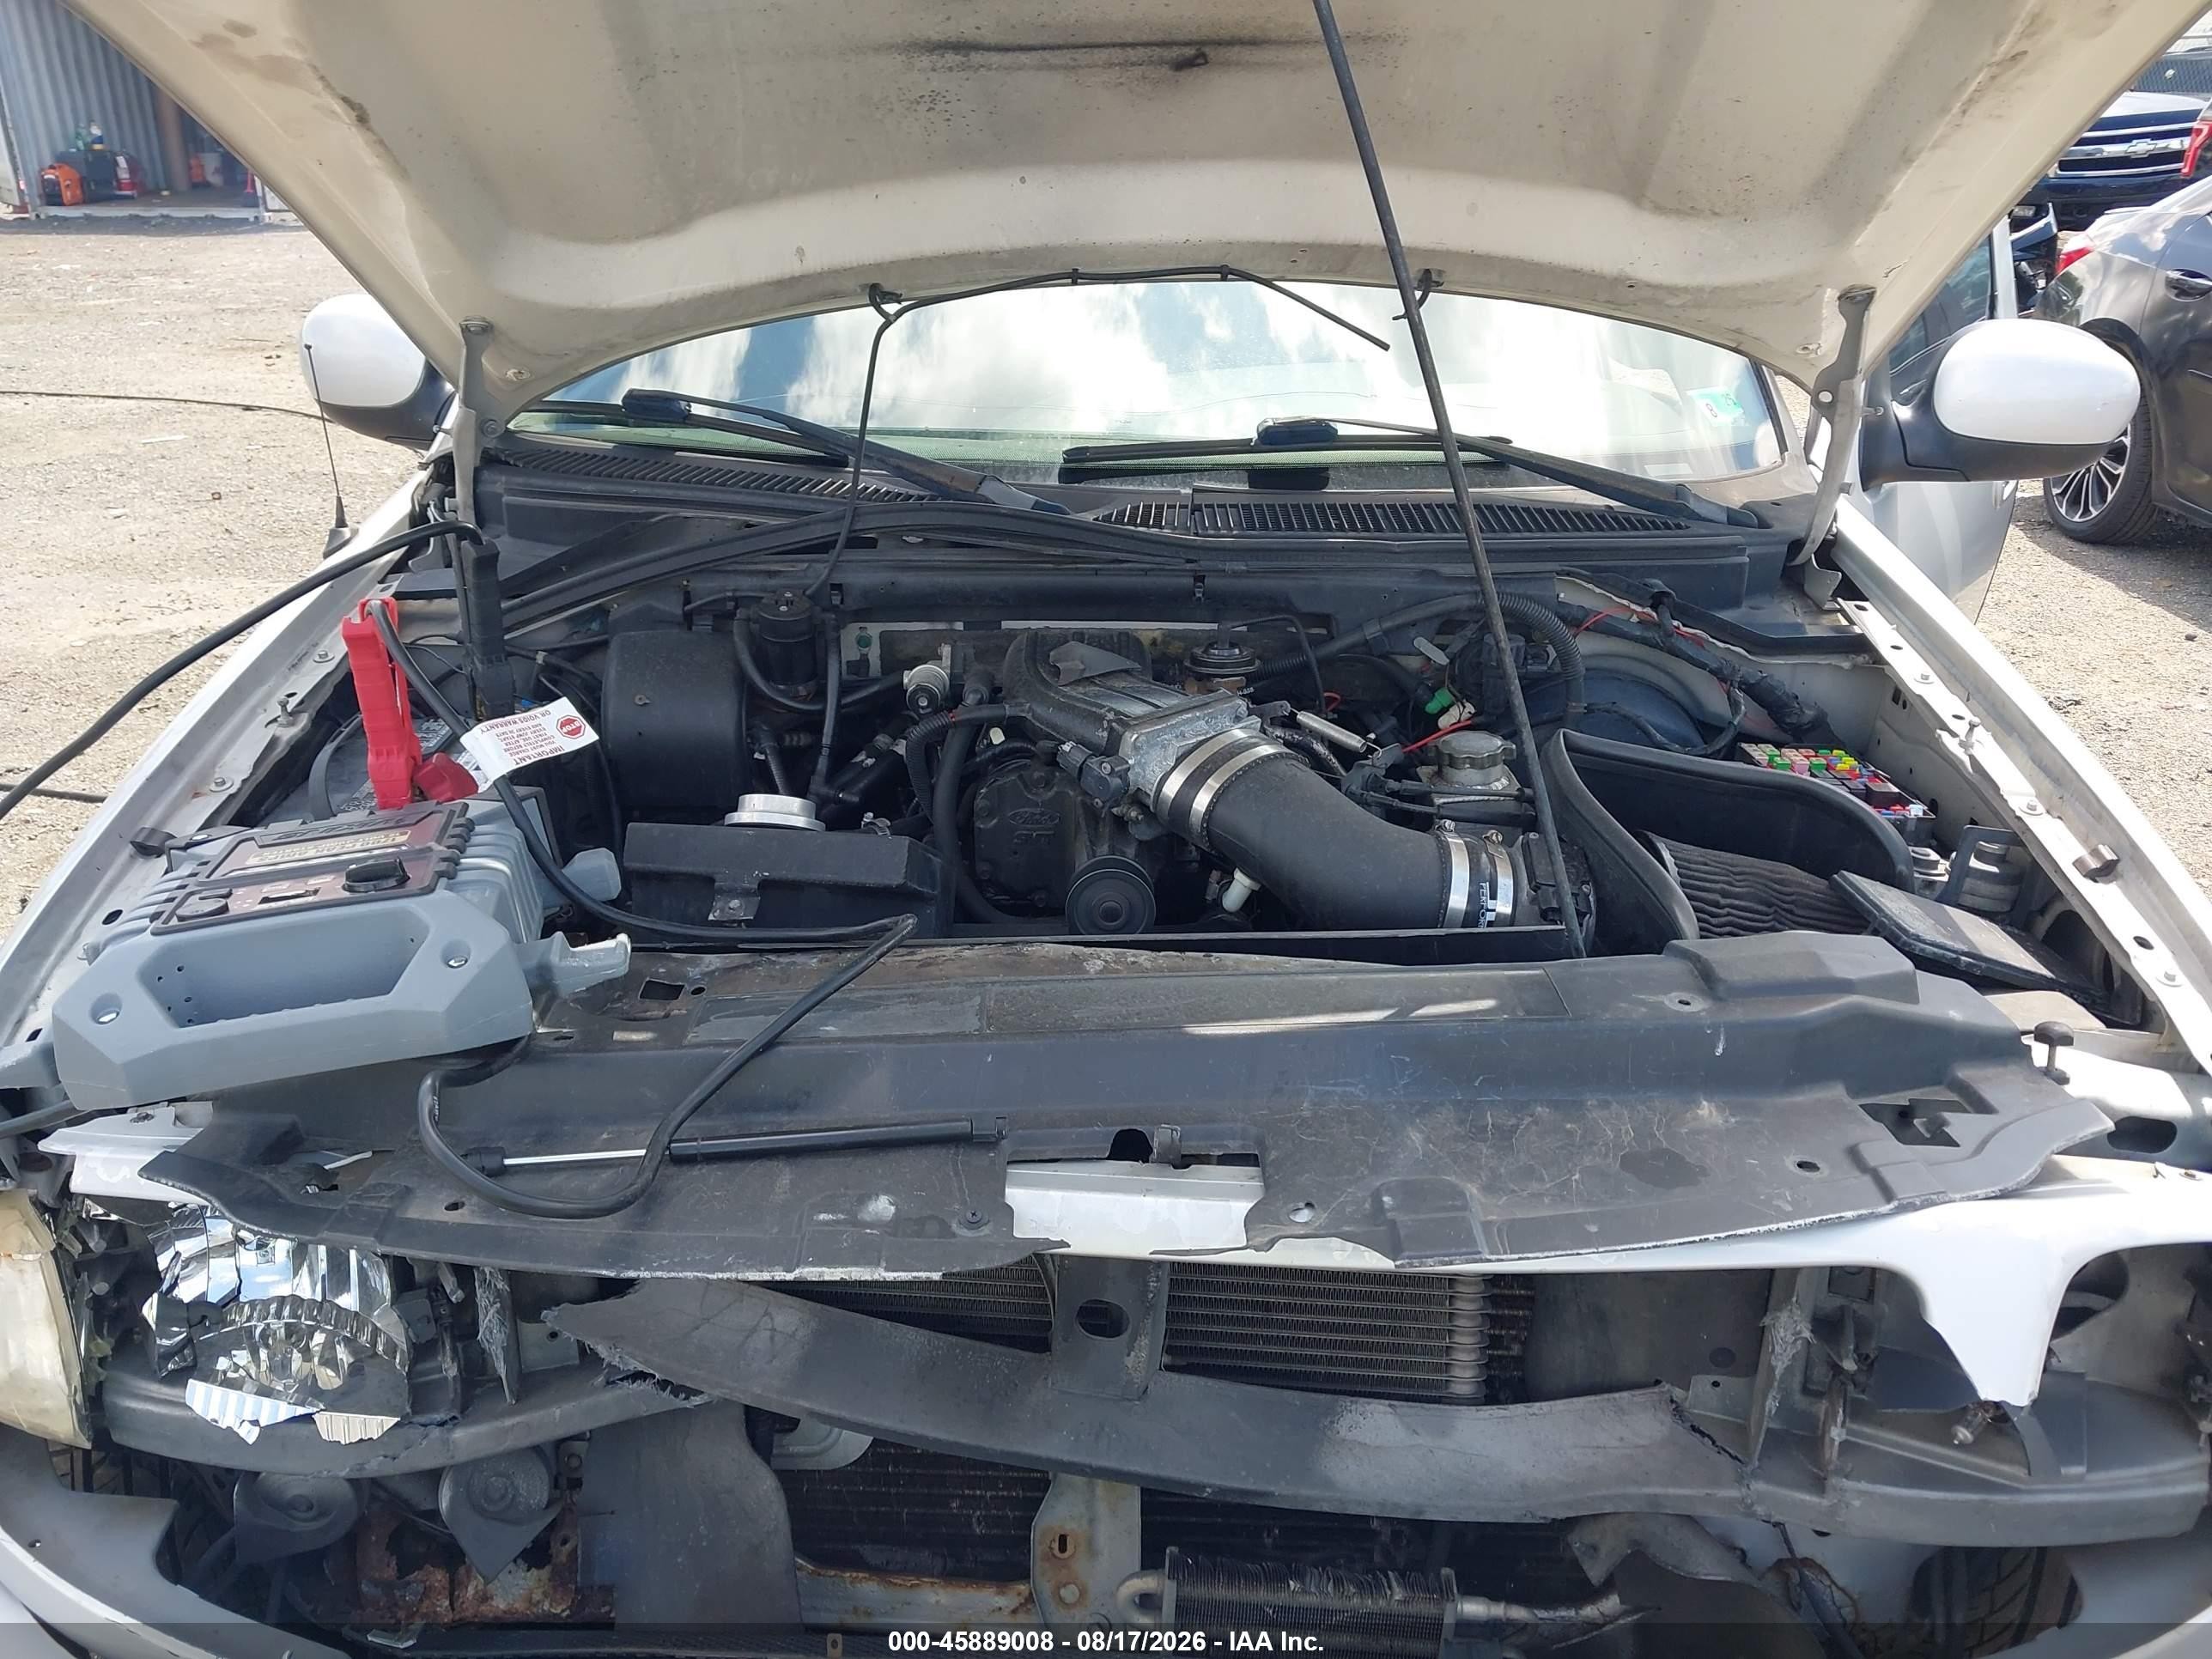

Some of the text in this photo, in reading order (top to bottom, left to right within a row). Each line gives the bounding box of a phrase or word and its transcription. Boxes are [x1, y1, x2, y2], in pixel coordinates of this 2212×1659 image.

[1705, 403, 1718, 418] 8
[518, 713, 539, 724] VOIDS
[562, 720, 580, 732] STOP
[480, 719, 517, 734] WARRANTY
[514, 745, 564, 765] IMPORTANT
